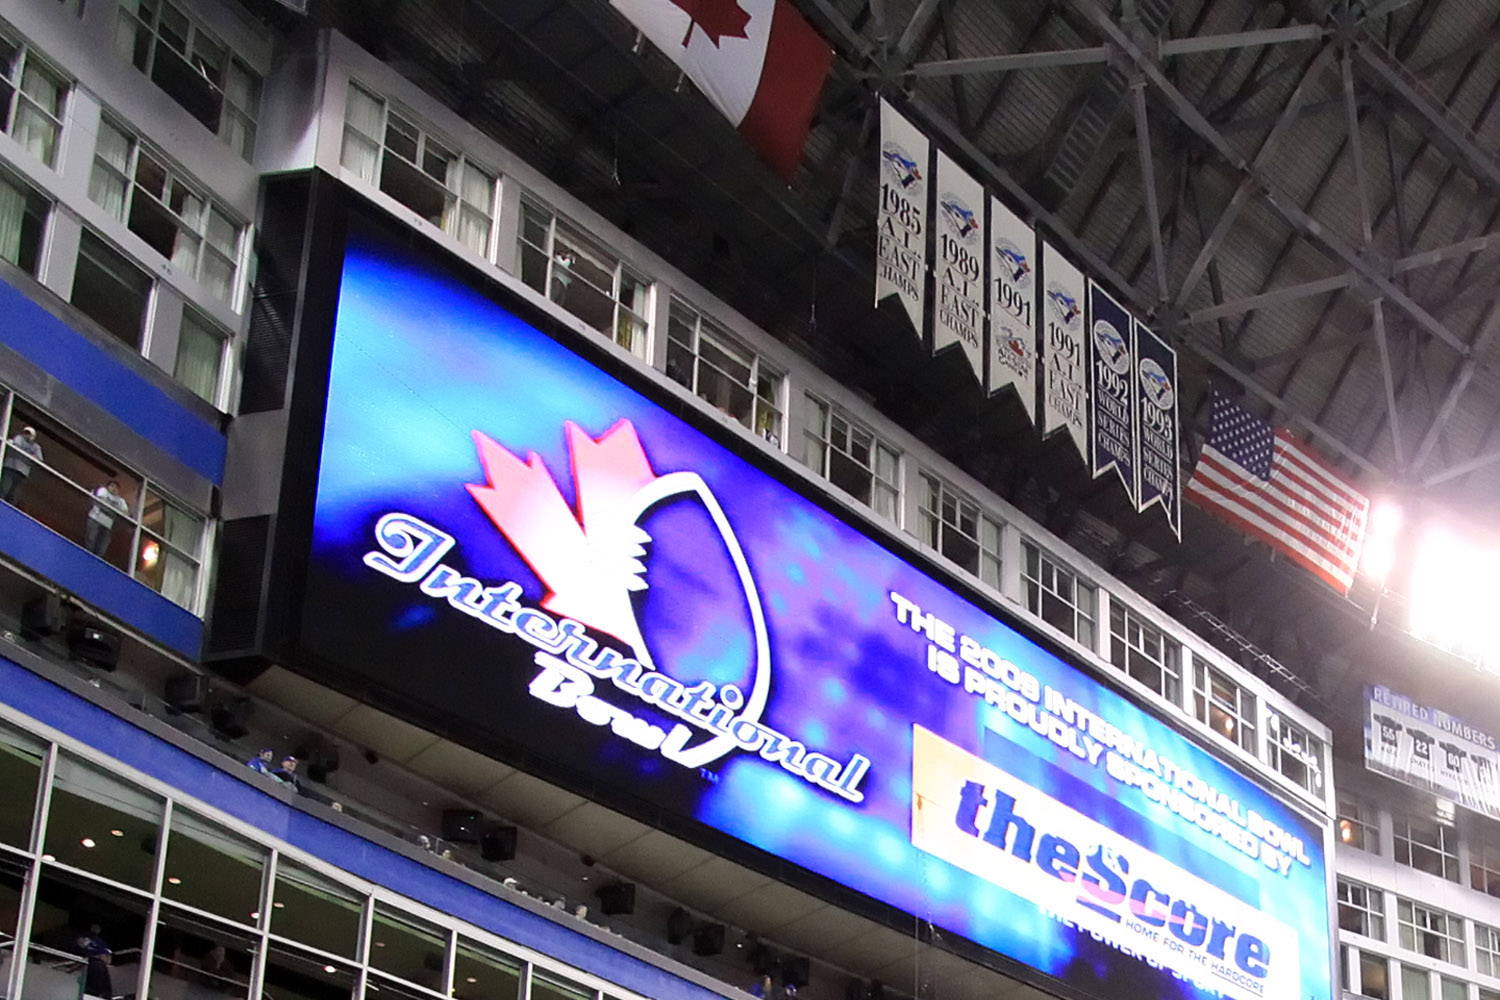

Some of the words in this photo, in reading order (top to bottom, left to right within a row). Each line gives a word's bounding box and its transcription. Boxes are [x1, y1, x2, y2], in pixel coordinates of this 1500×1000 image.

[882, 183, 922, 235] 1985
[879, 236, 919, 281] EAST
[941, 234, 980, 282] 1989
[941, 284, 979, 328] EAST
[994, 278, 1031, 328] 1991
[940, 309, 978, 350] CHAMPS
[1049, 322, 1080, 367] 1991
[1096, 360, 1128, 405] 1992
[1098, 389, 1129, 425] WORLD
[1098, 411, 1129, 447] SERIES
[1141, 397, 1172, 441] 1993
[1143, 426, 1173, 460] WORLD
[1143, 447, 1173, 481] SERIES
[363, 512, 870, 802] International
[529, 651, 737, 768] Bowl
[890, 592, 955, 652] THE
[960, 635, 1040, 702] 2009
[1045, 685, 1247, 827] INTERNATIONAL
[1248, 810, 1311, 866] BOWL
[1374, 687, 1428, 720] RETIRED
[1434, 709, 1496, 750] NUMBERS
[928, 645, 960, 684] IS
[965, 667, 1103, 765] PROUDLY
[1106, 751, 1259, 859] SPONSORED
[1261, 842, 1292, 876] BY
[1416, 739, 1428, 755] 22
[956, 780, 1271, 979] theScore
[1126, 919, 1159, 943] HOME
[1163, 937, 1184, 954] FOR
[1189, 950, 1208, 966] THE
[1211, 961, 1264, 994] HARDCORE
